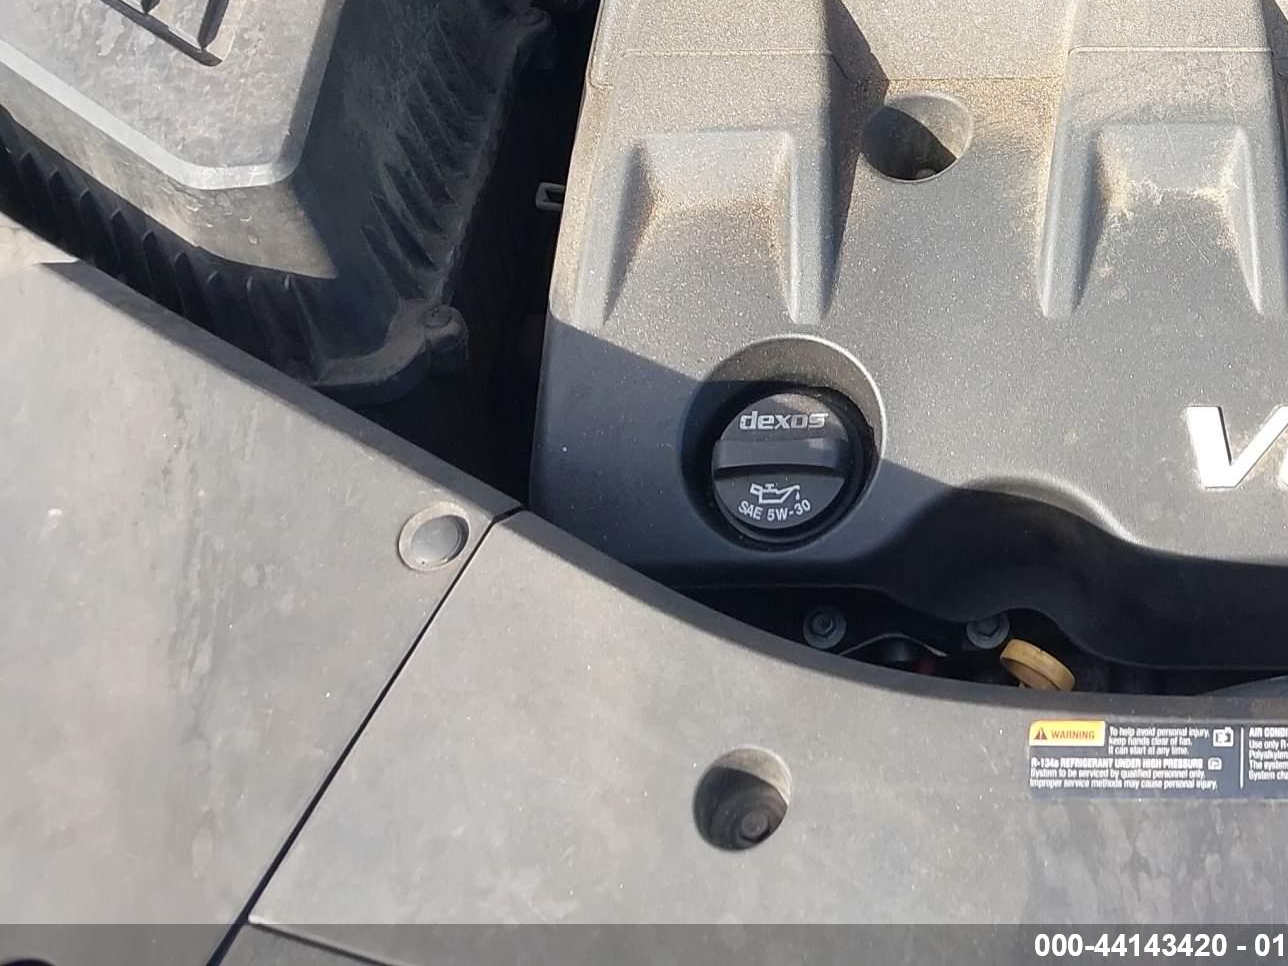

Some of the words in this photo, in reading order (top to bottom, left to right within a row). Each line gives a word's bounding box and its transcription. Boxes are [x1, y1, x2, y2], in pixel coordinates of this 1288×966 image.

[739, 411, 829, 430] dexos
[738, 500, 763, 520] SAE
[767, 499, 811, 521] 5W-30
[1051, 730, 1095, 739] WARNING
[1110, 727, 1118, 737] To
[1120, 727, 1134, 737] help
[1136, 727, 1155, 737] avoid
[1157, 727, 1186, 737] personal
[1249, 727, 1262, 737] AIR
[1151, 737, 1168, 746] clear
[1170, 737, 1177, 746] of
[1264, 740, 1279, 750] only
[1115, 746, 1128, 756] can
[1130, 746, 1146, 756] start
[1148, 746, 1154, 756] at
[1156, 746, 1169, 756] any
[1061, 758, 1113, 768] REFRIGERANT
[1115, 758, 1141, 768] UNDER
[1143, 758, 1161, 768] HIGH
[1249, 761, 1262, 770] The
[1264, 761, 1288, 770] system
[1059, 769, 1066, 778] to
[1068, 769, 1076, 778] be
[1079, 769, 1108, 778] serviced
[1110, 769, 1119, 778] by
[1153, 769, 1187, 778] personnel
[1249, 771, 1275, 781] System
[1064, 779, 1089, 789] service
[1091, 779, 1122, 789] methods
[1124, 779, 1139, 789] may
[1141, 779, 1162, 789] cause
[1164, 779, 1194, 789] personal
